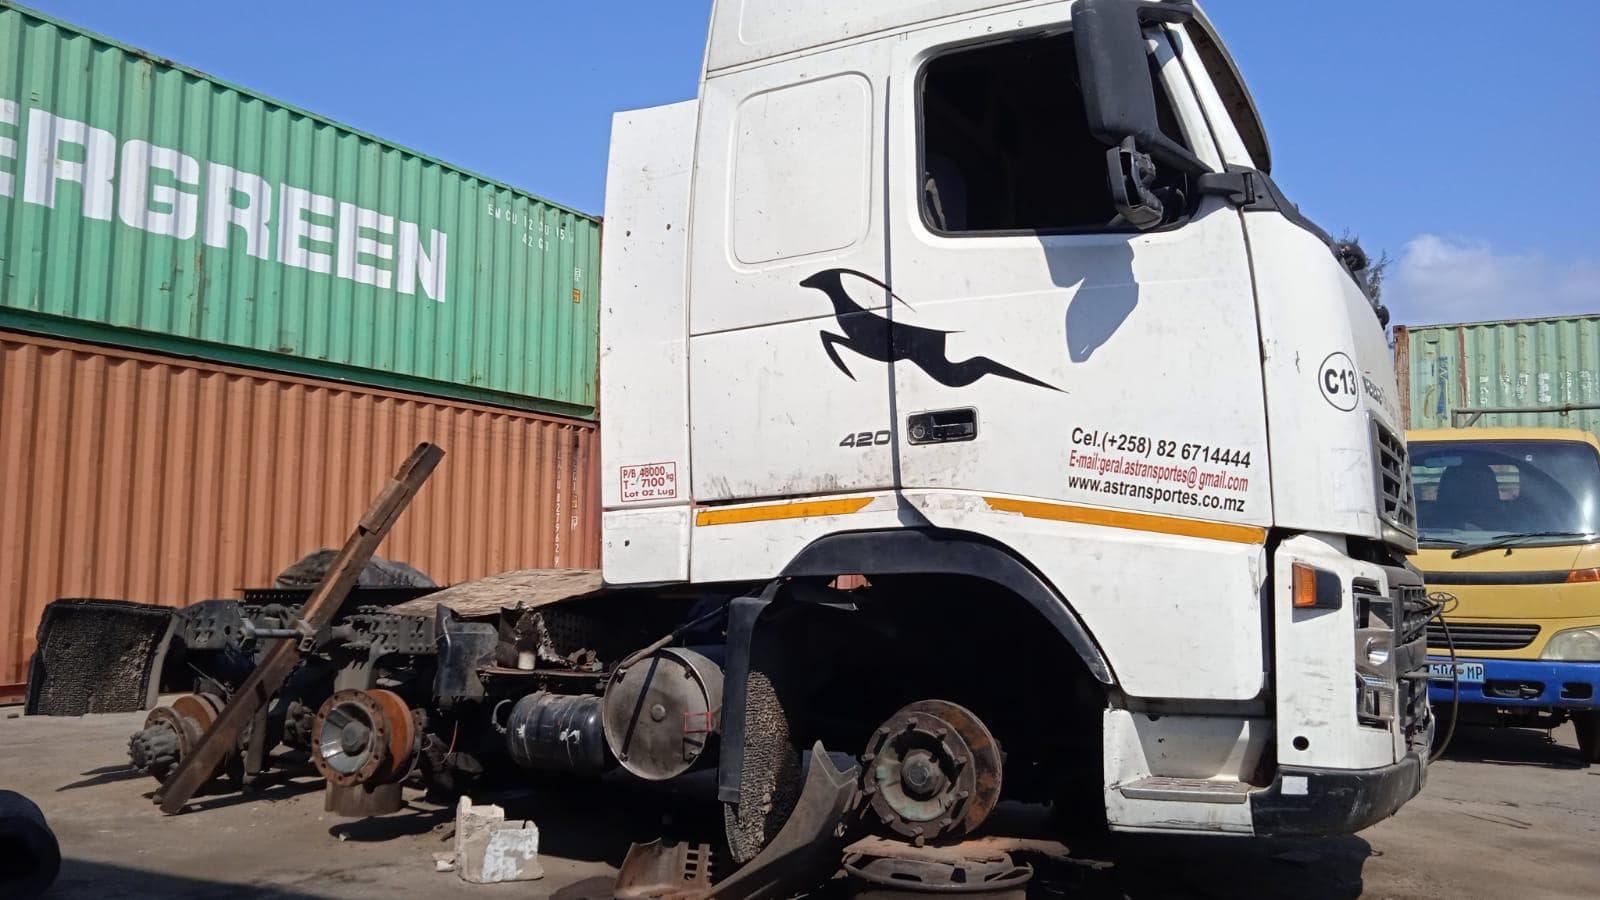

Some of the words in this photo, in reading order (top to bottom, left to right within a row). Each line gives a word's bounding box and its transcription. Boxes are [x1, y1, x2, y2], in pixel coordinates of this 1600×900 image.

[0, 98, 447, 303] RGREEN
[1324, 369, 1357, 396] C13
[839, 430, 891, 448] 420
[1156, 440, 1177, 458] 82
[1181, 443, 1251, 469] 6714444
[641, 477, 665, 488] 7100
[1068, 476, 1245, 512] www.astransportes.co.mz
[1467, 666, 1483, 680] MP
